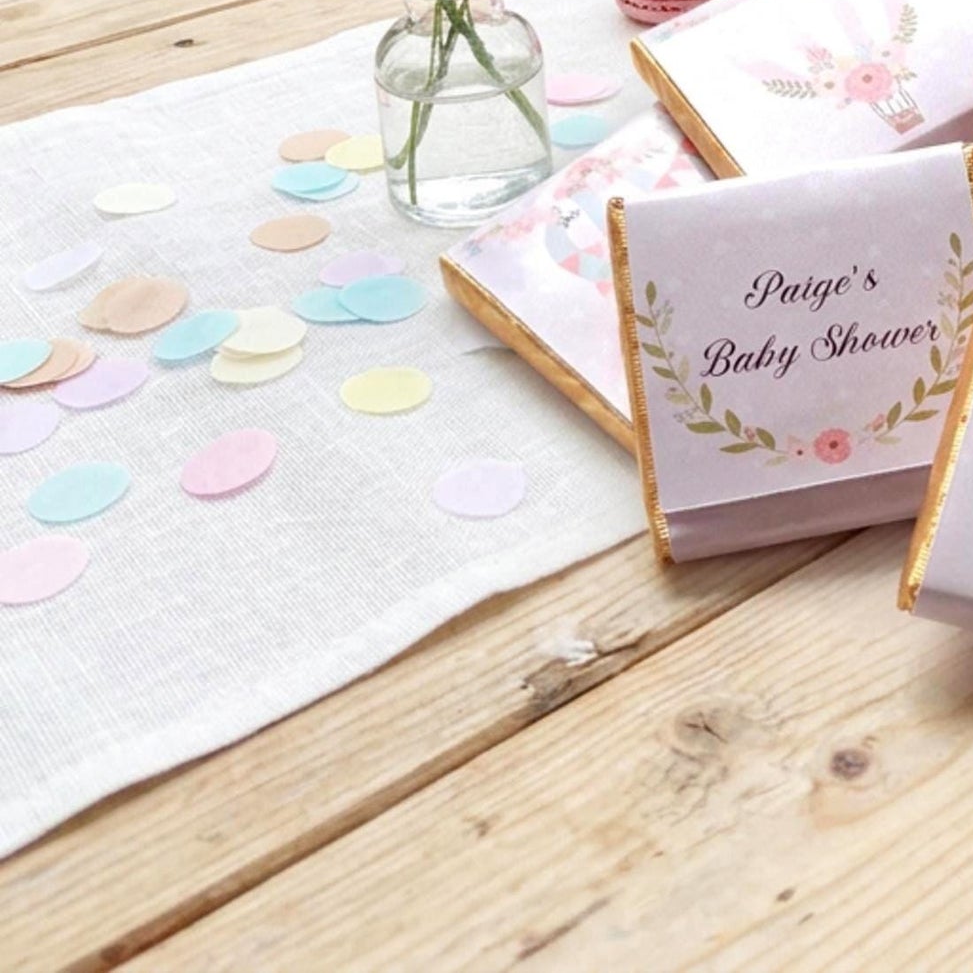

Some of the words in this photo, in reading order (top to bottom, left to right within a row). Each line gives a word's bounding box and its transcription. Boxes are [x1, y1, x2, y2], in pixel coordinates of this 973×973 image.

[744, 265, 878, 312] Paige's
[700, 334, 800, 379] Baby
[810, 320, 940, 362] Shower
